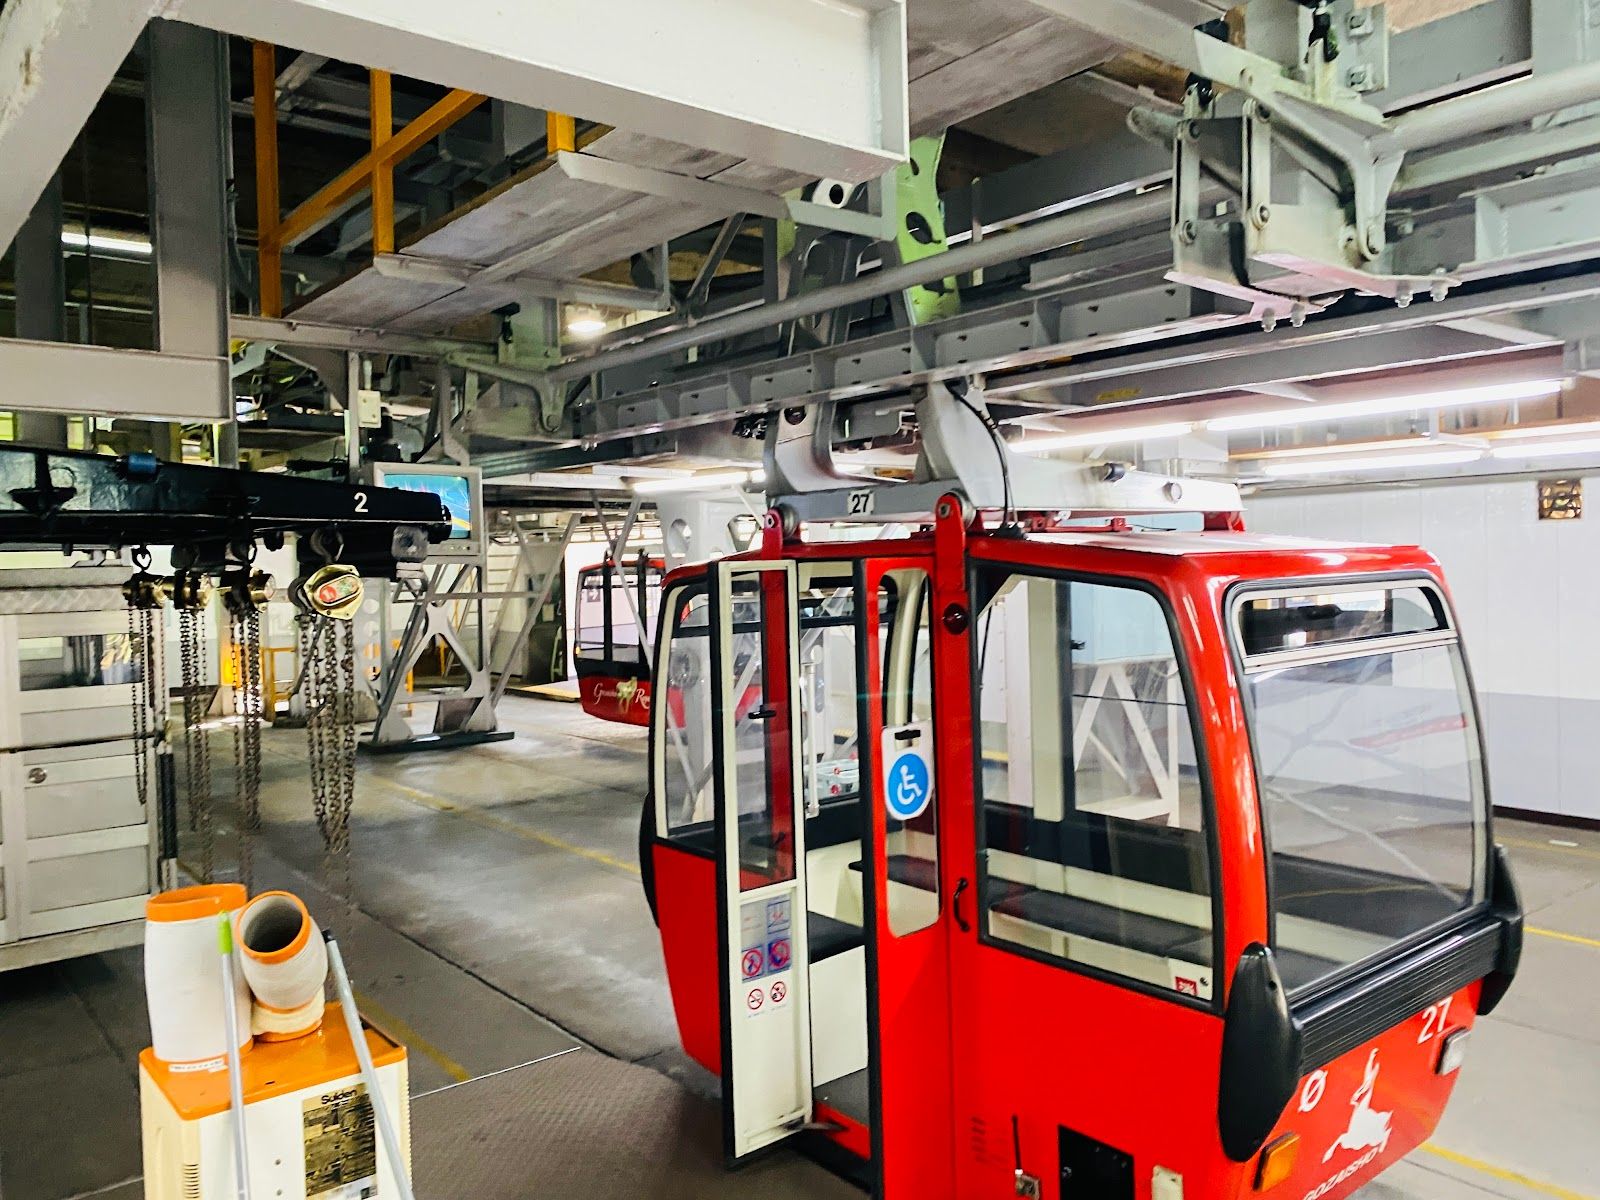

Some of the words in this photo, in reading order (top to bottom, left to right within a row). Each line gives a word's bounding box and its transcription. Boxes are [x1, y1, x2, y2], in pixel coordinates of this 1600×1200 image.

[354, 492, 368, 512] 2
[852, 494, 869, 513] 27
[1417, 996, 1453, 1044] 27
